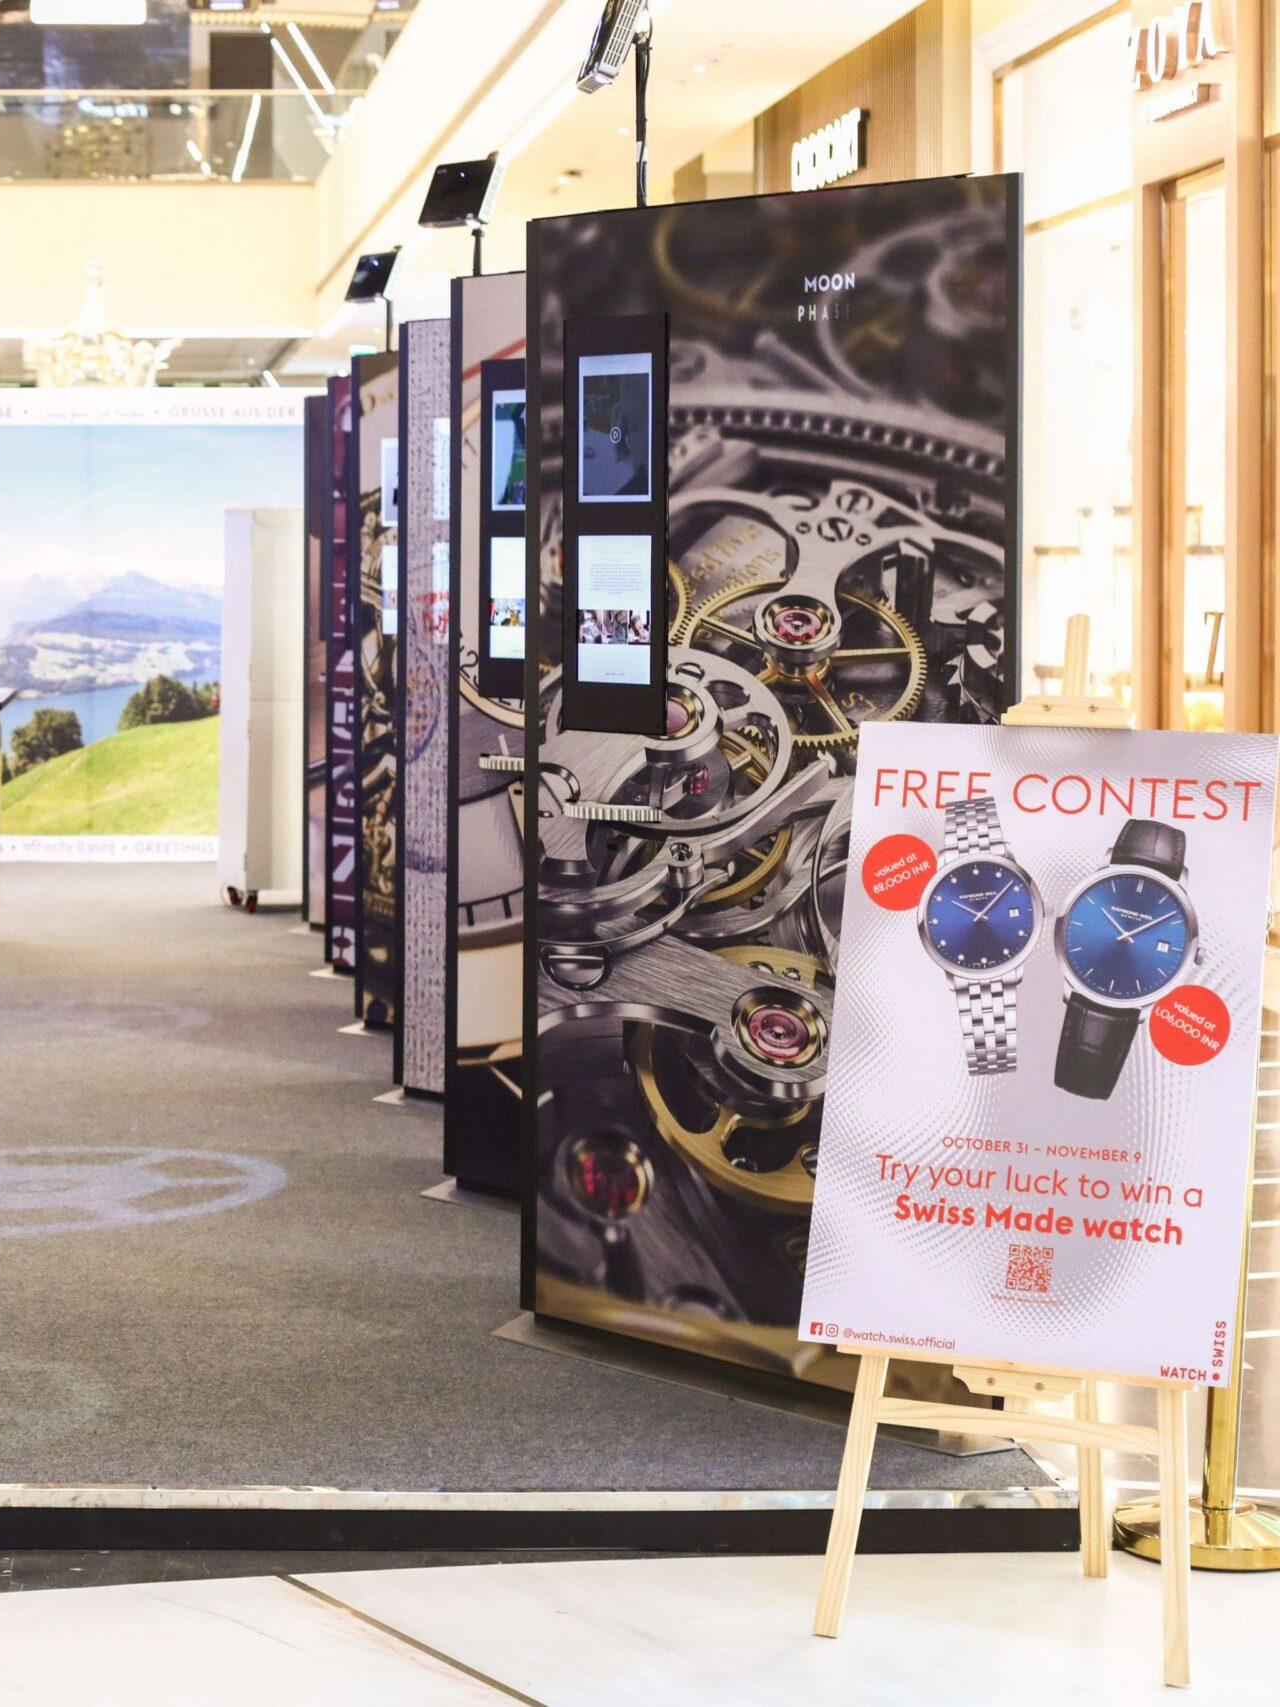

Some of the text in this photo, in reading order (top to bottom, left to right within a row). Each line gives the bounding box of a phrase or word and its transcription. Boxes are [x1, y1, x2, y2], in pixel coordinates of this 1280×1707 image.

[804, 272, 856, 293] MOON
[267, 406, 296, 418] DER
[873, 768, 1262, 821] FREE CONTEST
[134, 841, 215, 854] GREETINGS
[874, 853, 918, 878] valued at
[912, 861, 931, 876] INR
[1174, 1001, 1217, 1032] valued at
[1201, 1034, 1220, 1051] INR
[942, 1136, 1012, 1154] OCTOBER
[1016, 1142, 1029, 1154] 31
[1046, 1145, 1129, 1163] NOVEMBER
[1133, 1151, 1142, 1164] 9
[875, 1153, 1203, 1208] Try your luck to win a
[894, 1194, 1183, 1246] Swiss Made watch
[842, 1327, 956, 1350] @watch.swiss.official
[1212, 1320, 1227, 1368] SWISS
[1160, 1365, 1207, 1381] WATCH
